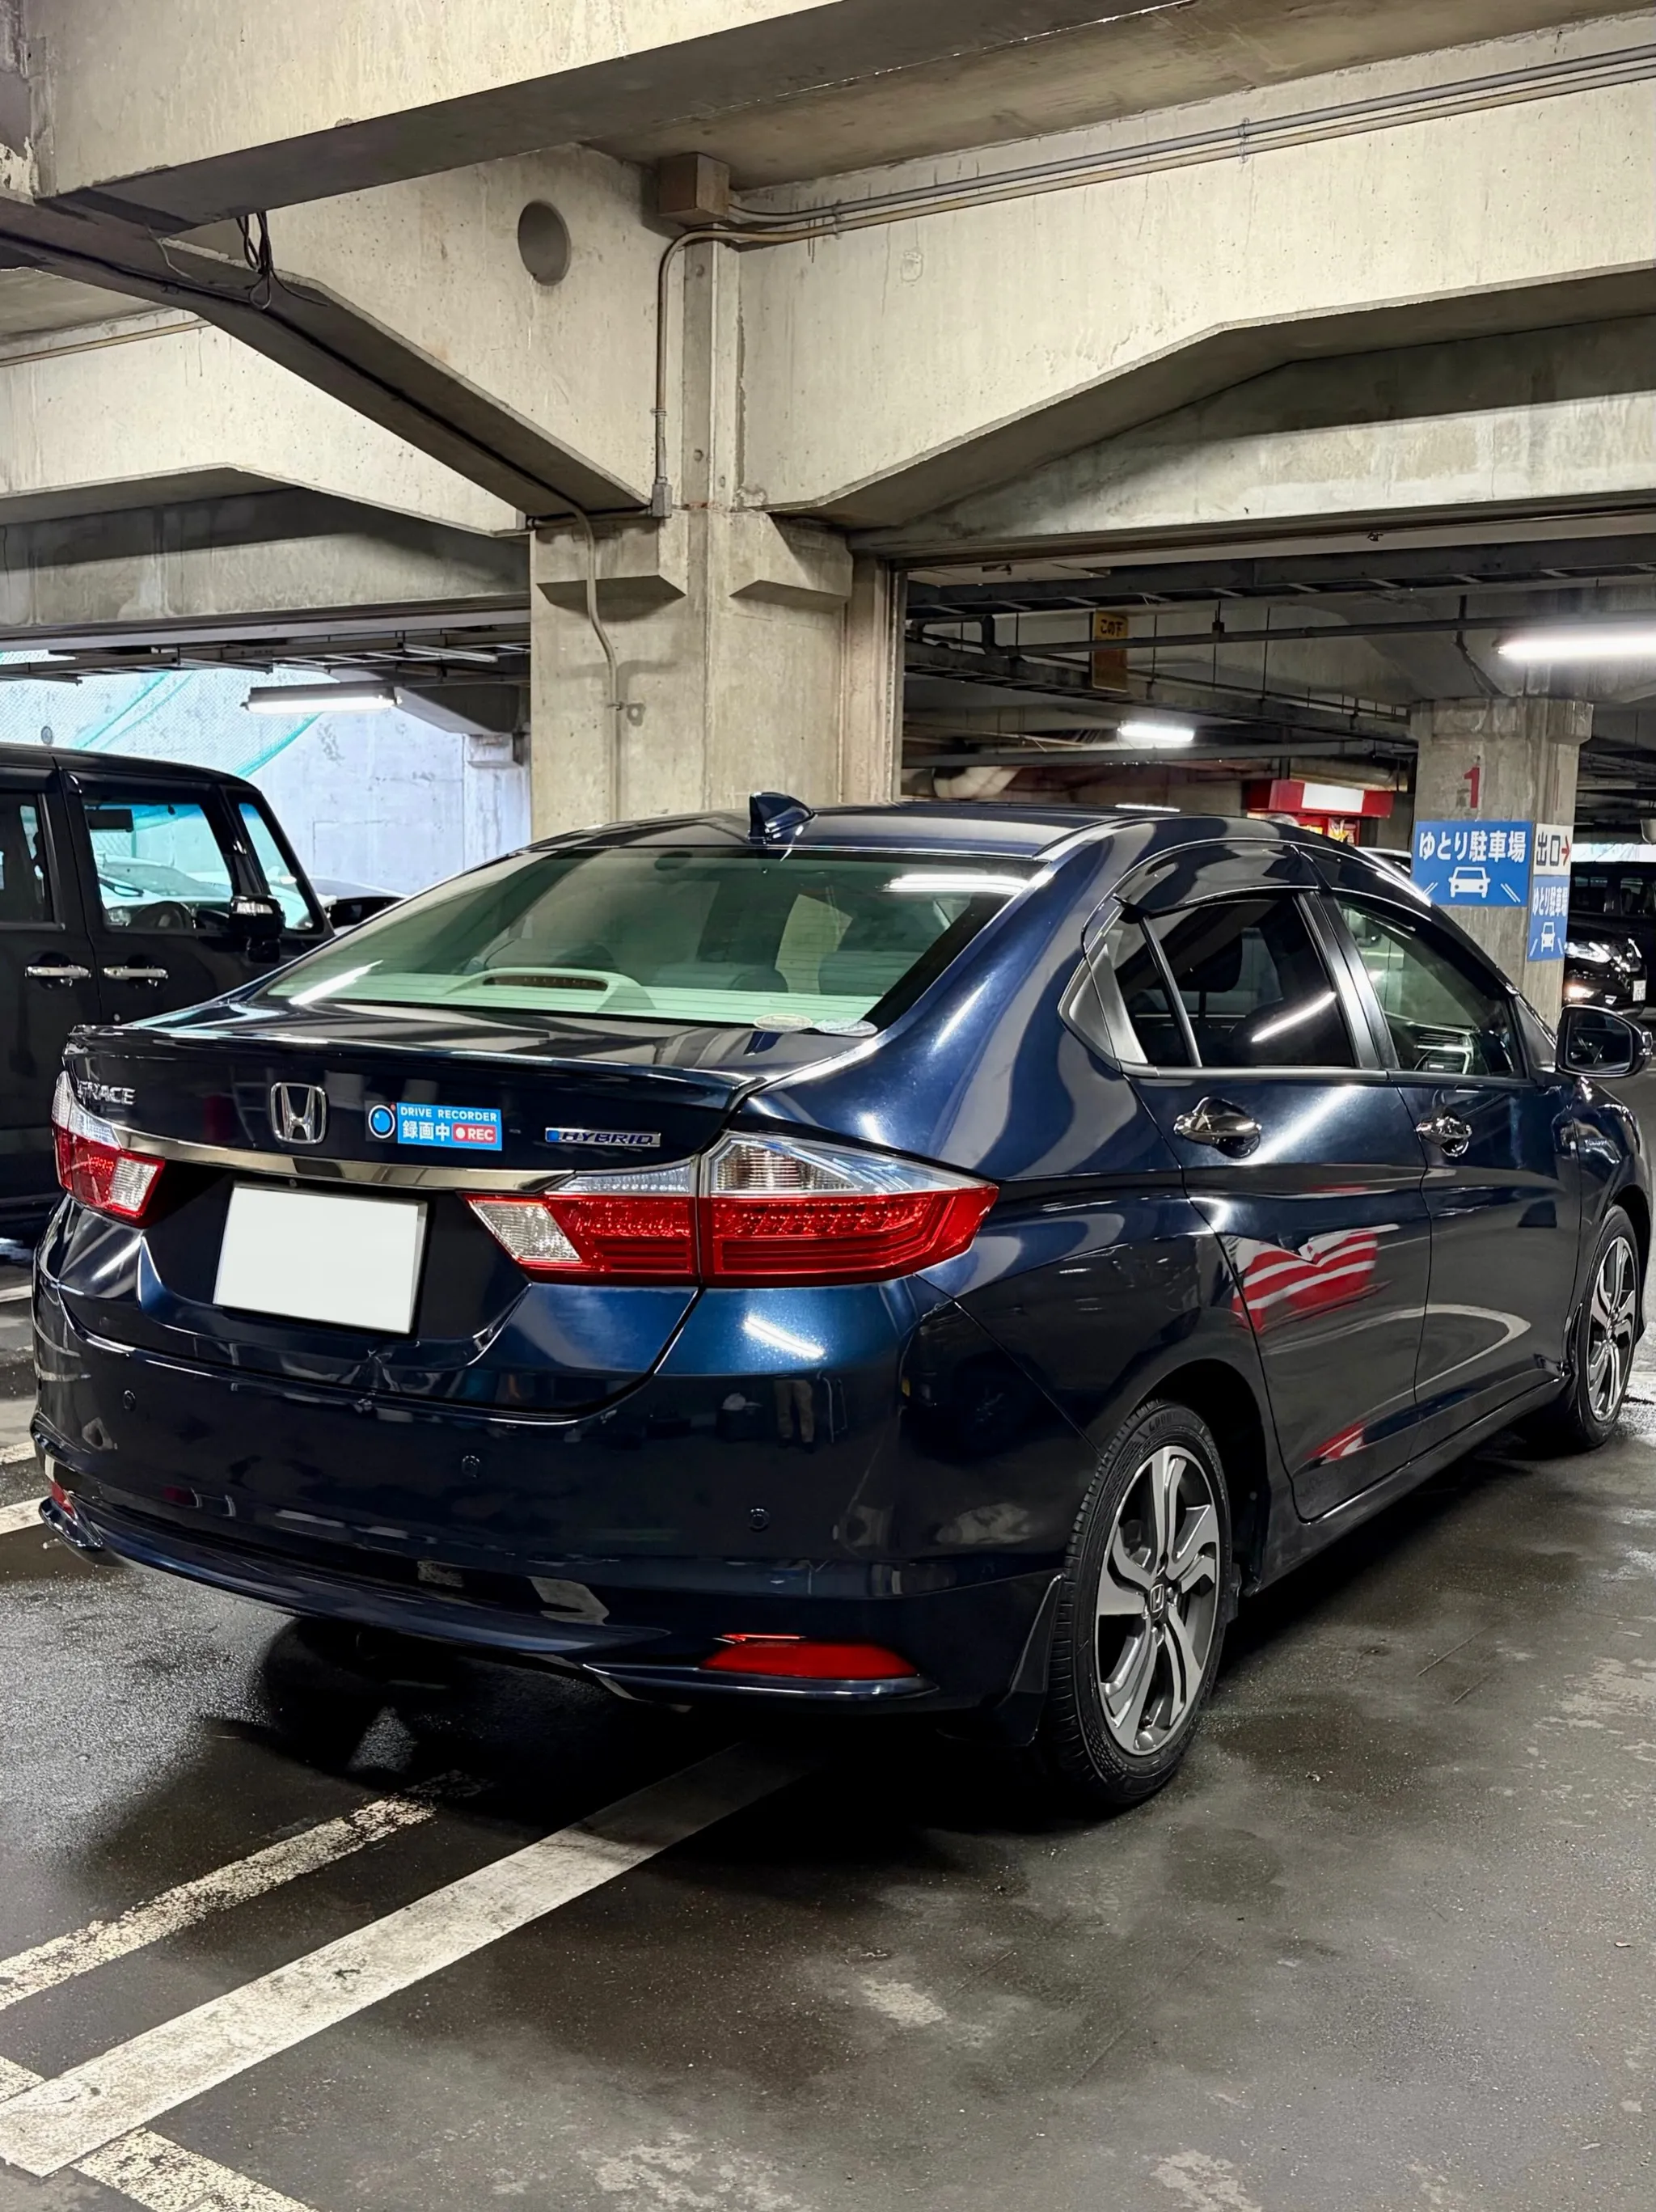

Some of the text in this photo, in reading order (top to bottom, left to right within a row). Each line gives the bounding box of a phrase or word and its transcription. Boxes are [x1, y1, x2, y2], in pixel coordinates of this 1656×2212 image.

[1464, 767, 1481, 809] 1
[1419, 830, 1527, 864] ゆとり駐車場
[1536, 831, 1561, 867] 出口
[1532, 886, 1569, 917] ゆとり駐車場
[400, 1106, 497, 1122] DRIVE RECORDER
[403, 1119, 450, 1141] 録画中
[467, 1127, 494, 1140] REC
[562, 1131, 653, 1145] HYBRID
